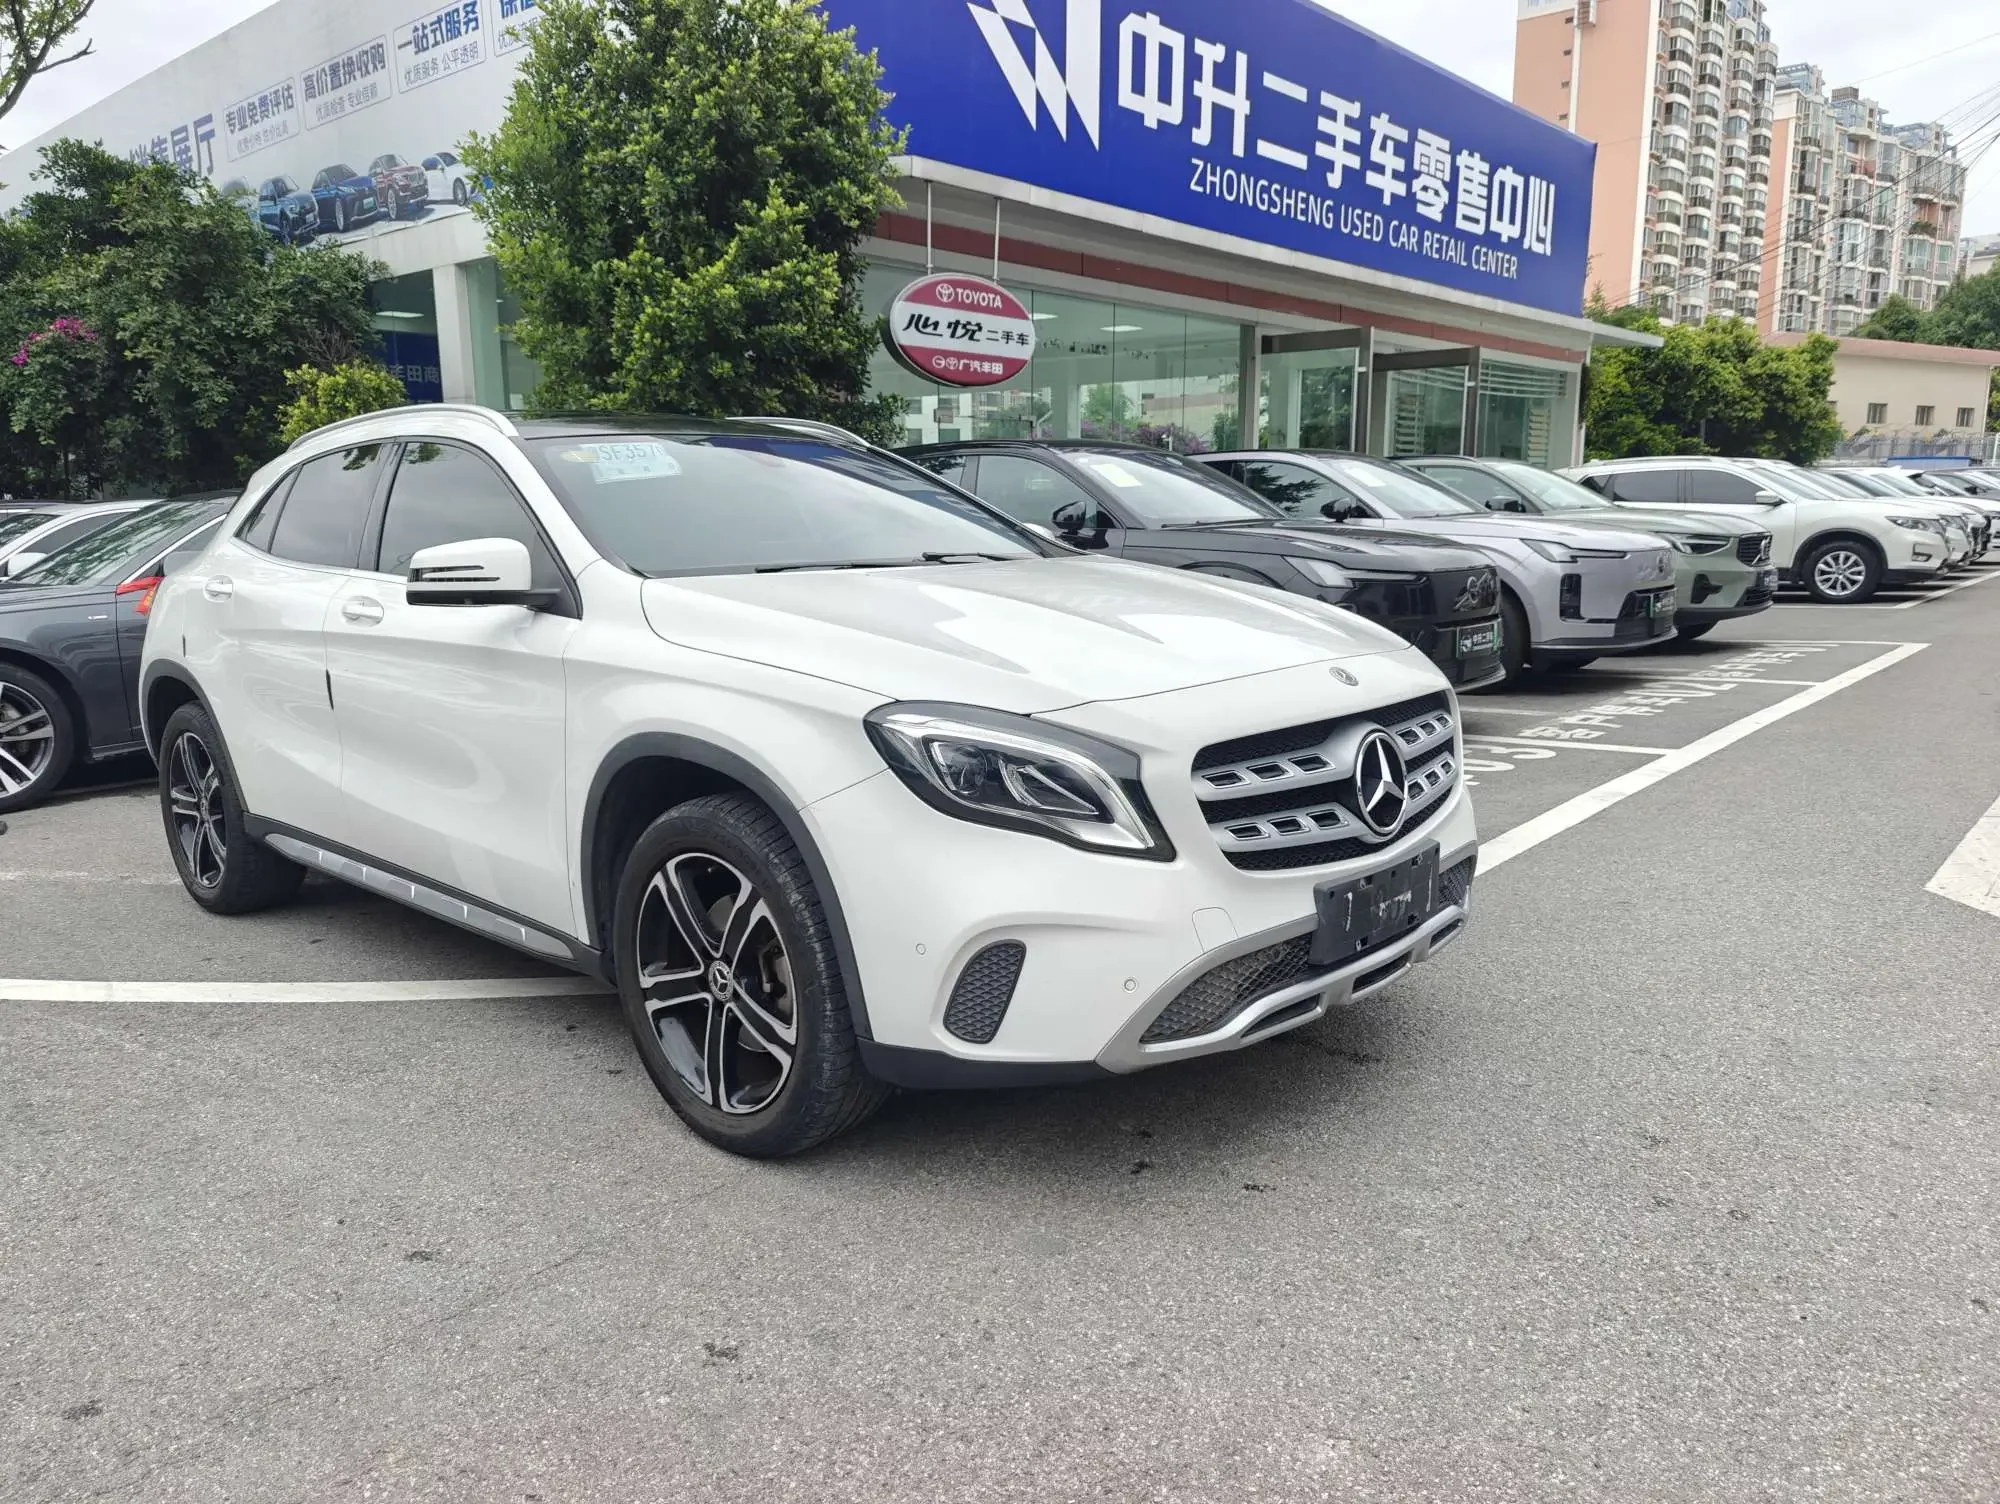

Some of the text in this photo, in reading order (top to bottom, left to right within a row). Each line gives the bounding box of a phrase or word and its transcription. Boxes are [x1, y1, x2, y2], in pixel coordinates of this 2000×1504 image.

[398, 1, 479, 55] 一站式服务
[303, 35, 386, 102] 高价置换收购
[404, 41, 479, 87] 优质服务 公平透明
[225, 84, 295, 135] 专业免费评估
[1118, 13, 1556, 257] 中升二手车零售中心
[1190, 159, 1518, 280] ZHONGSHENG USED CAR RETAIL CENTER
[956, 288, 1003, 309] TOYOTA
[903, 313, 1030, 346] 心悦二手车
[959, 358, 1003, 375] 广汽丰田
